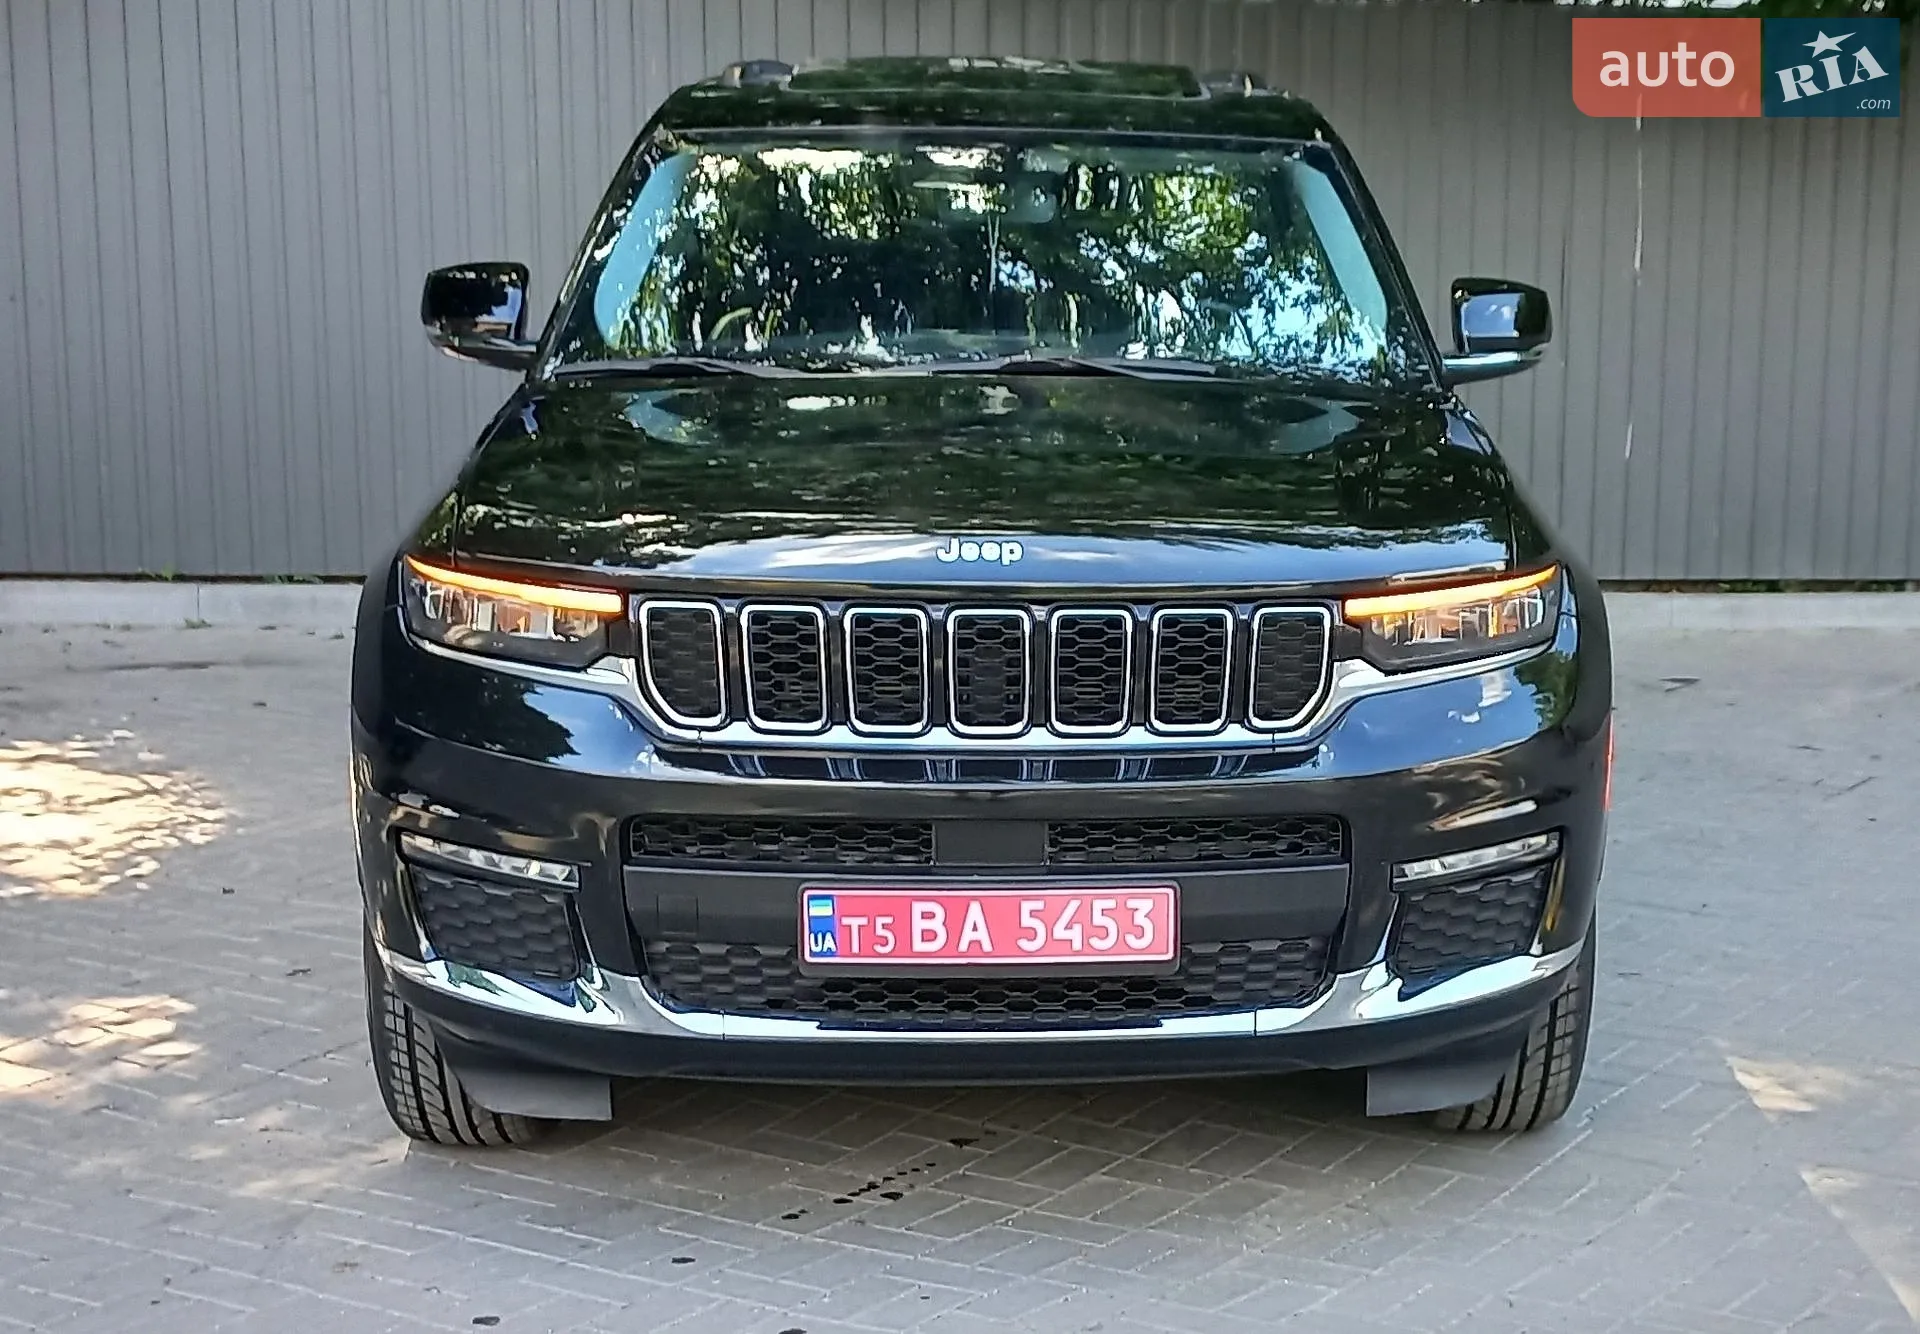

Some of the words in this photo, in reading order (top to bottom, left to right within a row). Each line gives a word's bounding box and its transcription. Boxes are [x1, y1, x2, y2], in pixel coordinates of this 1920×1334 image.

[809, 932, 837, 953] UA
[841, 915, 897, 954] T5
[911, 900, 994, 953] BA
[1016, 898, 1155, 952] 5453
